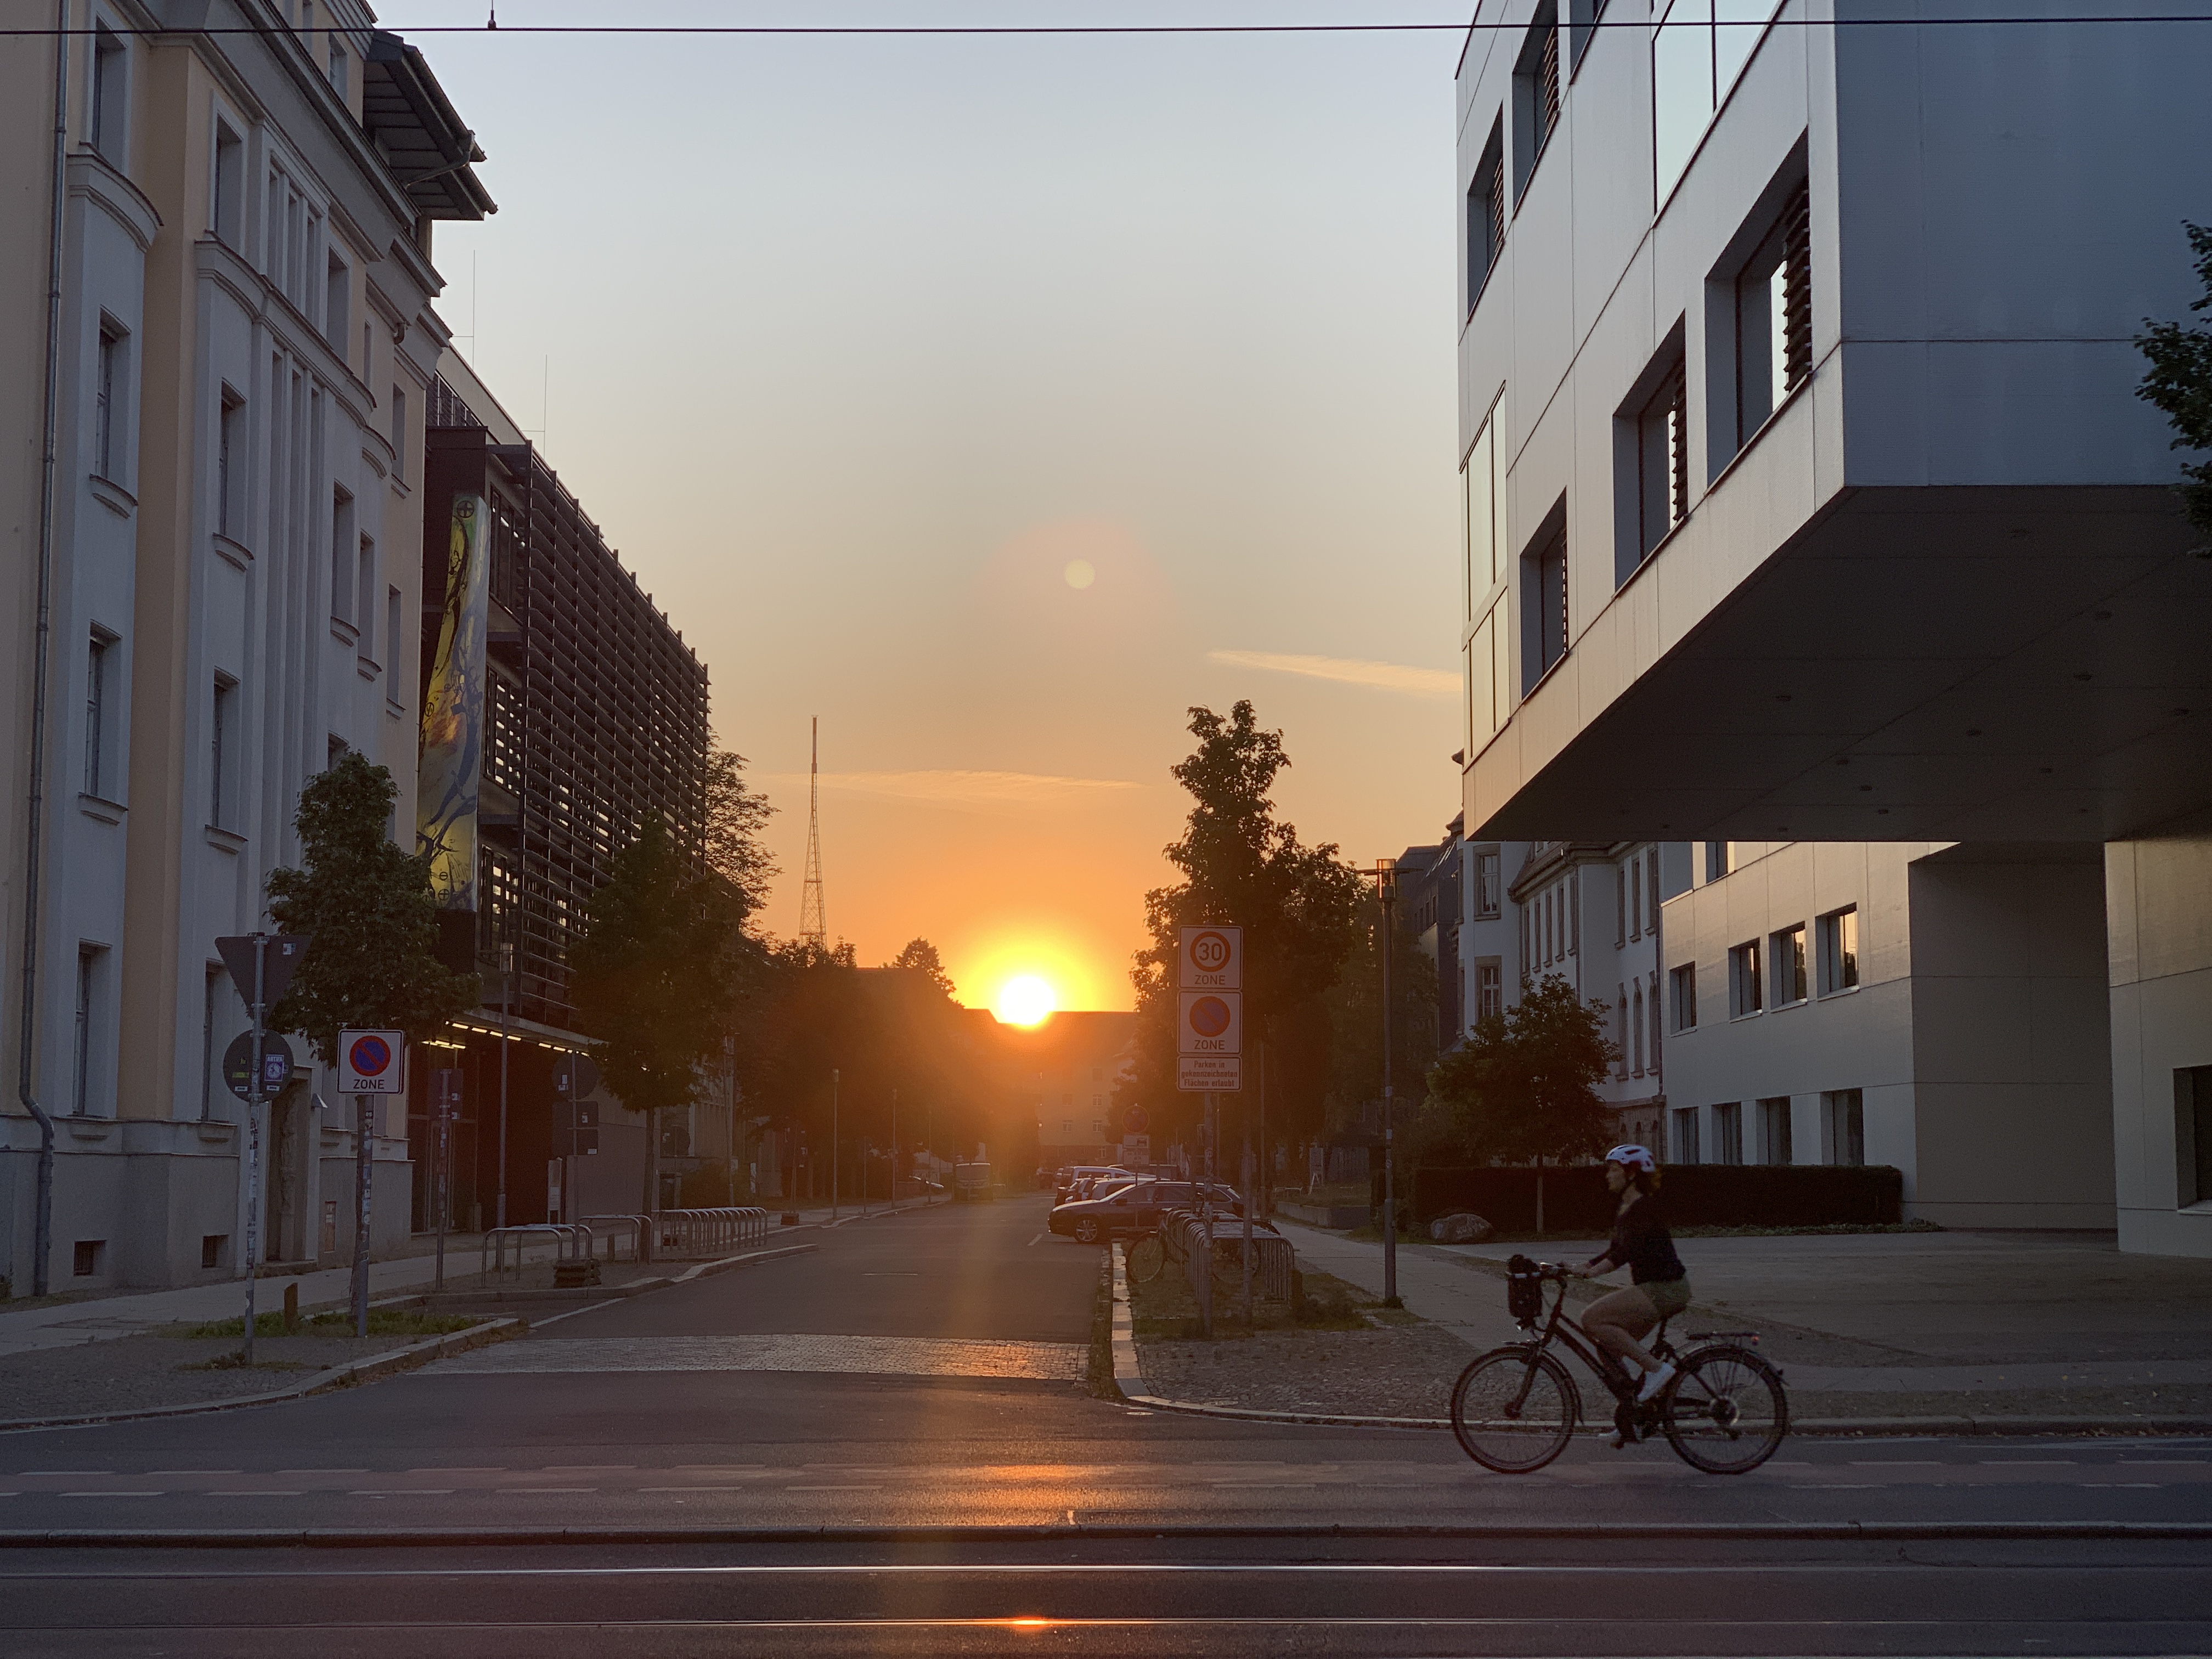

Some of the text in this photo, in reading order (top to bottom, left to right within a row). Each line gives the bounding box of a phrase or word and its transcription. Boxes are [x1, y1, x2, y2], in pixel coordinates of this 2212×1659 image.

[1199, 943, 1222, 961] 30
[1194, 974, 1226, 985] ZONE
[1194, 1040, 1225, 1050] ZONE
[1194, 1060, 1225, 1068] Parken in
[1181, 1070, 1238, 1079] gekennzeichneten
[353, 1079, 385, 1089] ZONE
[1184, 1079, 1234, 1087] Flächen erlaubt
